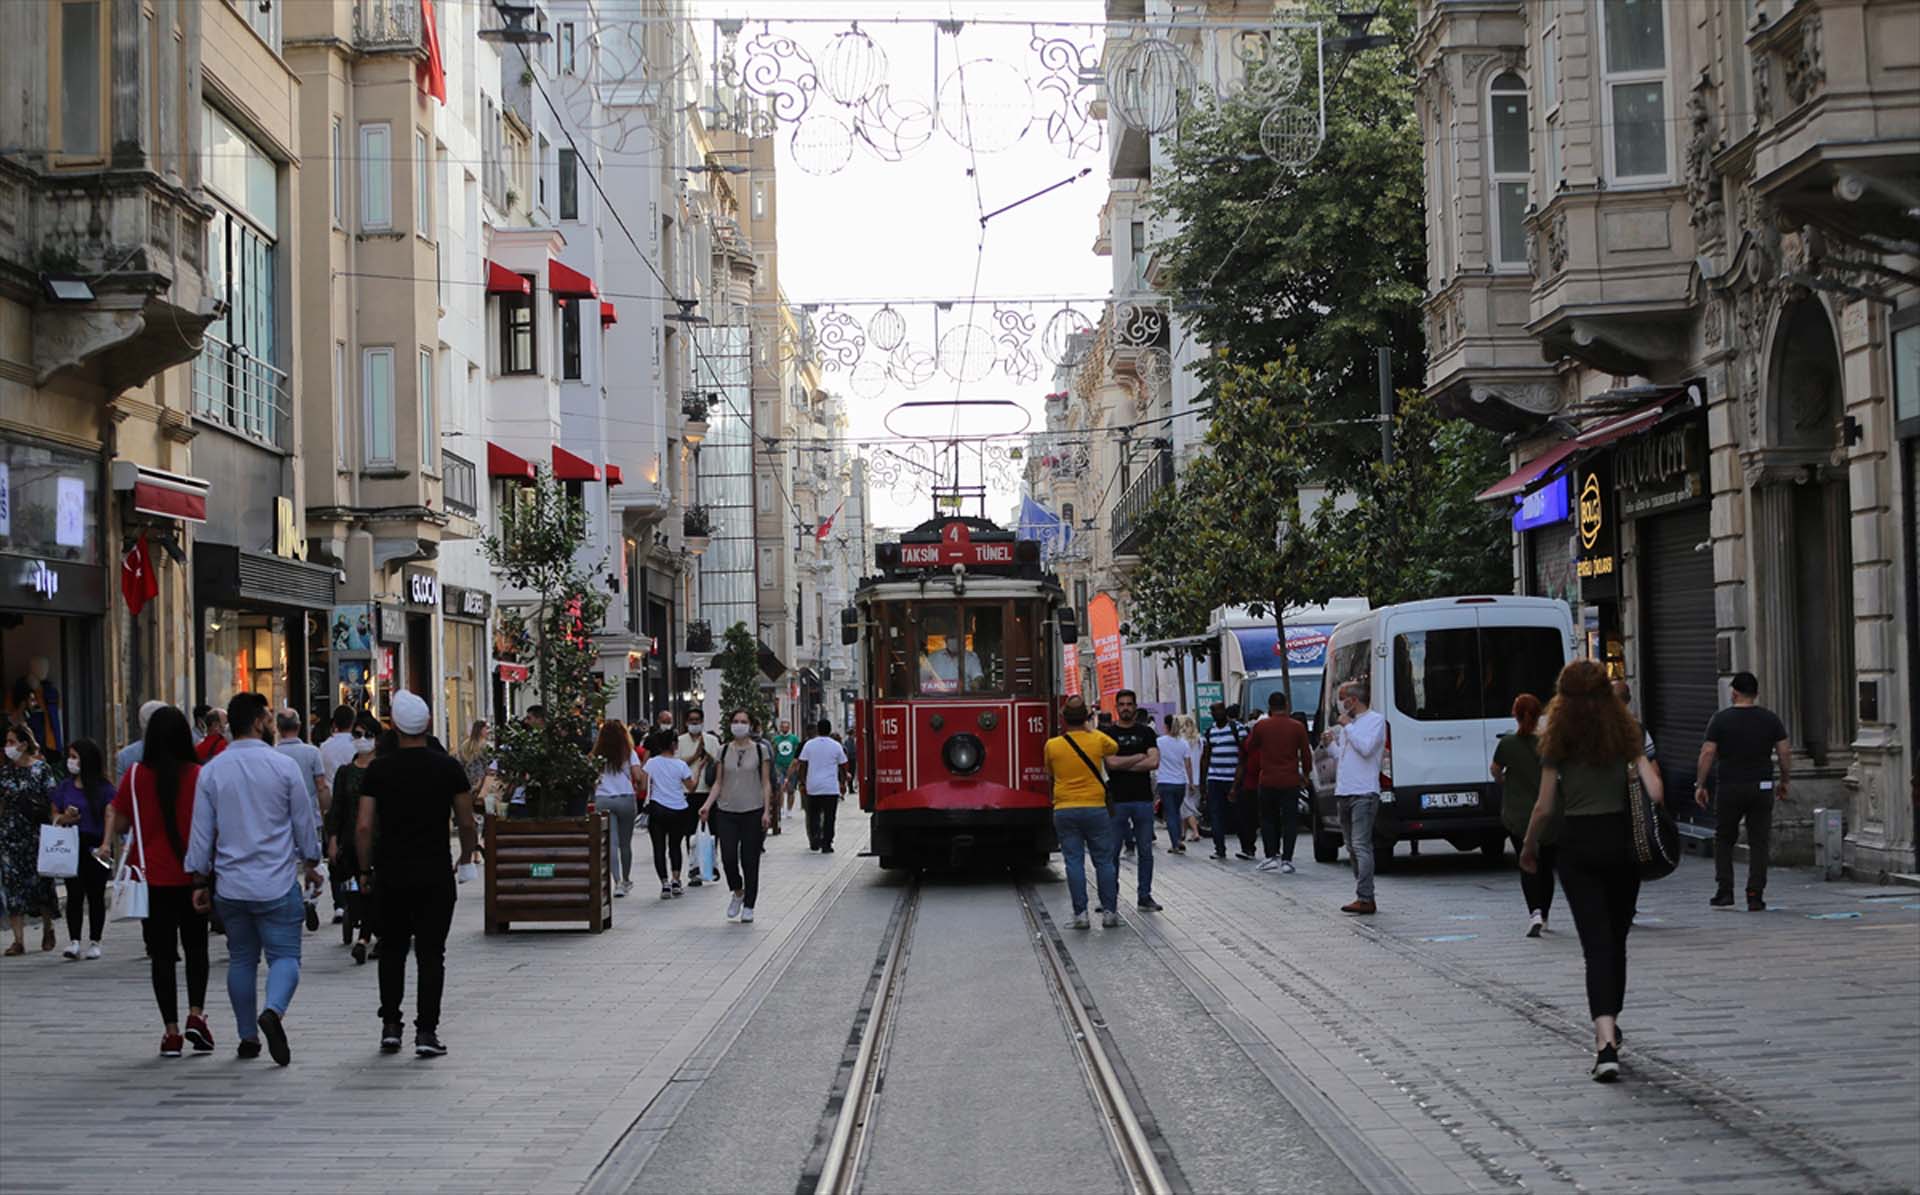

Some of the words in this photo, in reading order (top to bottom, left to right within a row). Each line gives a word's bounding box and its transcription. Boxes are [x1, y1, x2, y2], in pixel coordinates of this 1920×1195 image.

[950, 527, 959, 542] 4
[901, 545, 939, 563] TAKSİM
[976, 545, 1012, 562] TÜNEL
[881, 718, 898, 735] 115
[1027, 716, 1043, 733] 115
